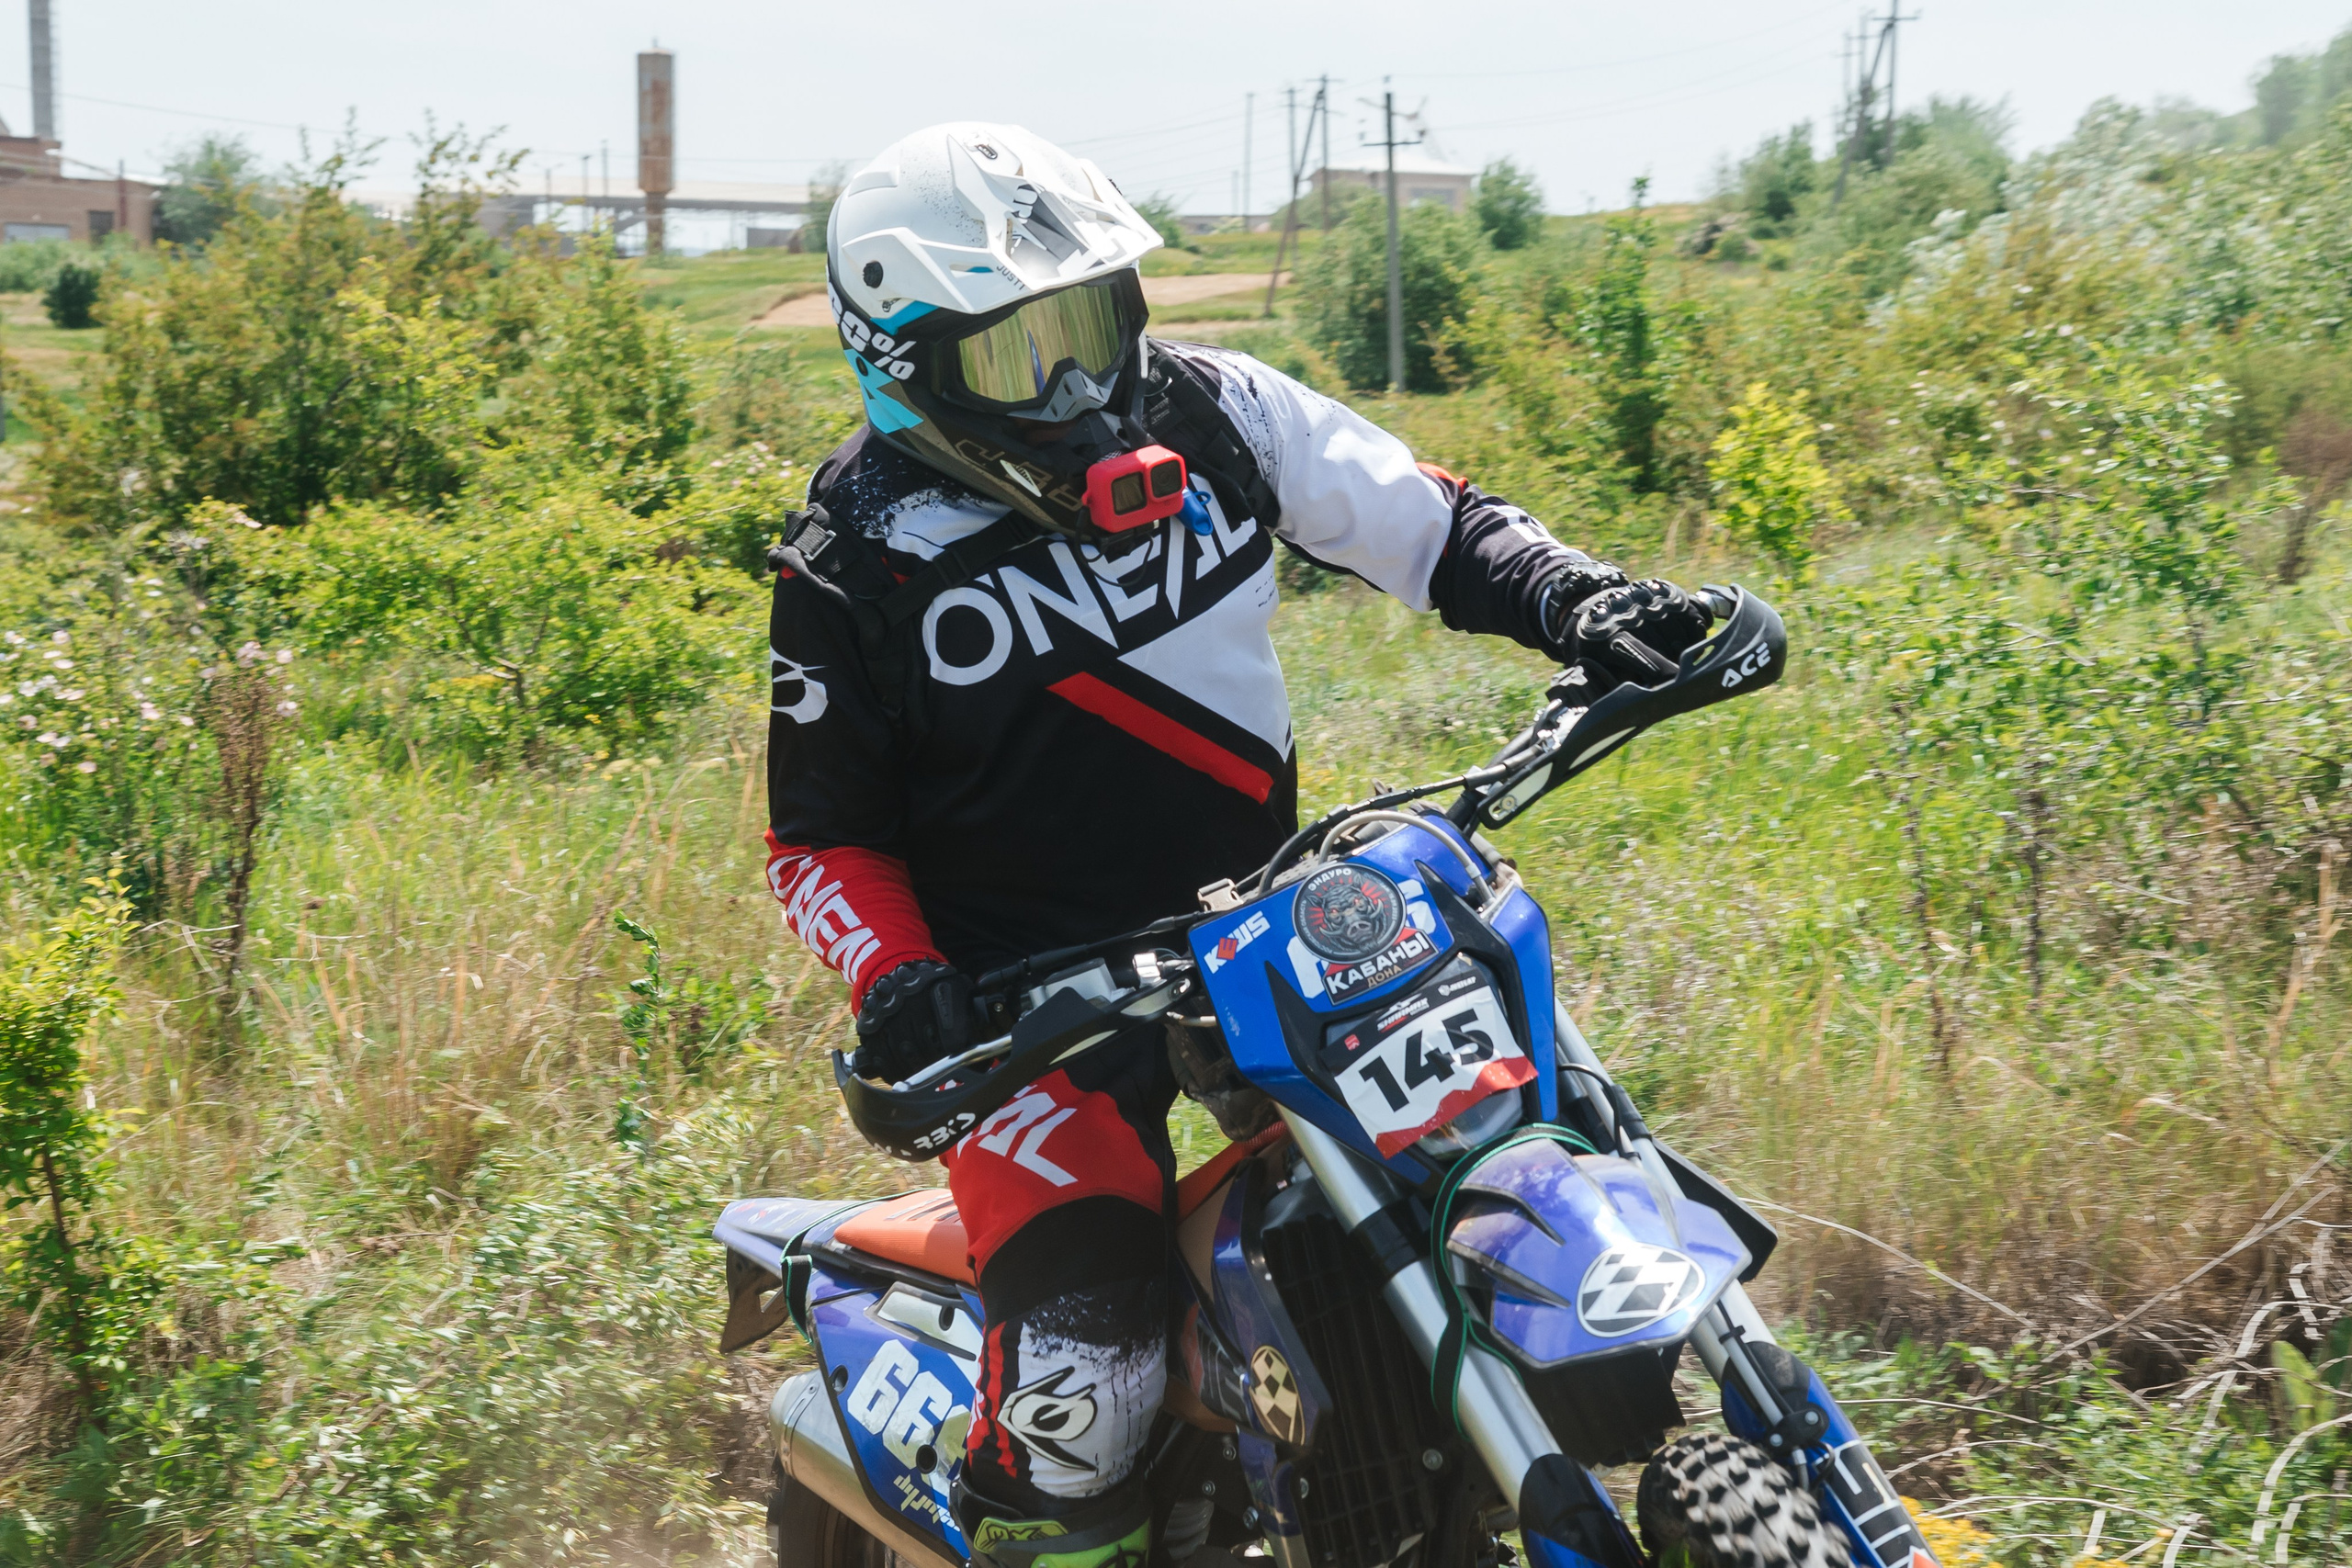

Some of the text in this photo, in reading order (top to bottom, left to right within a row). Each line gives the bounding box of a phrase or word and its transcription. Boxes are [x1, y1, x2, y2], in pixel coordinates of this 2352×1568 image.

[1307, 867, 1352, 891] ЭНДУРО
[1326, 932, 1430, 994] КАБАНЫ
[1366, 965, 1403, 988] ДОНА
[1359, 1009, 1495, 1112] 145
